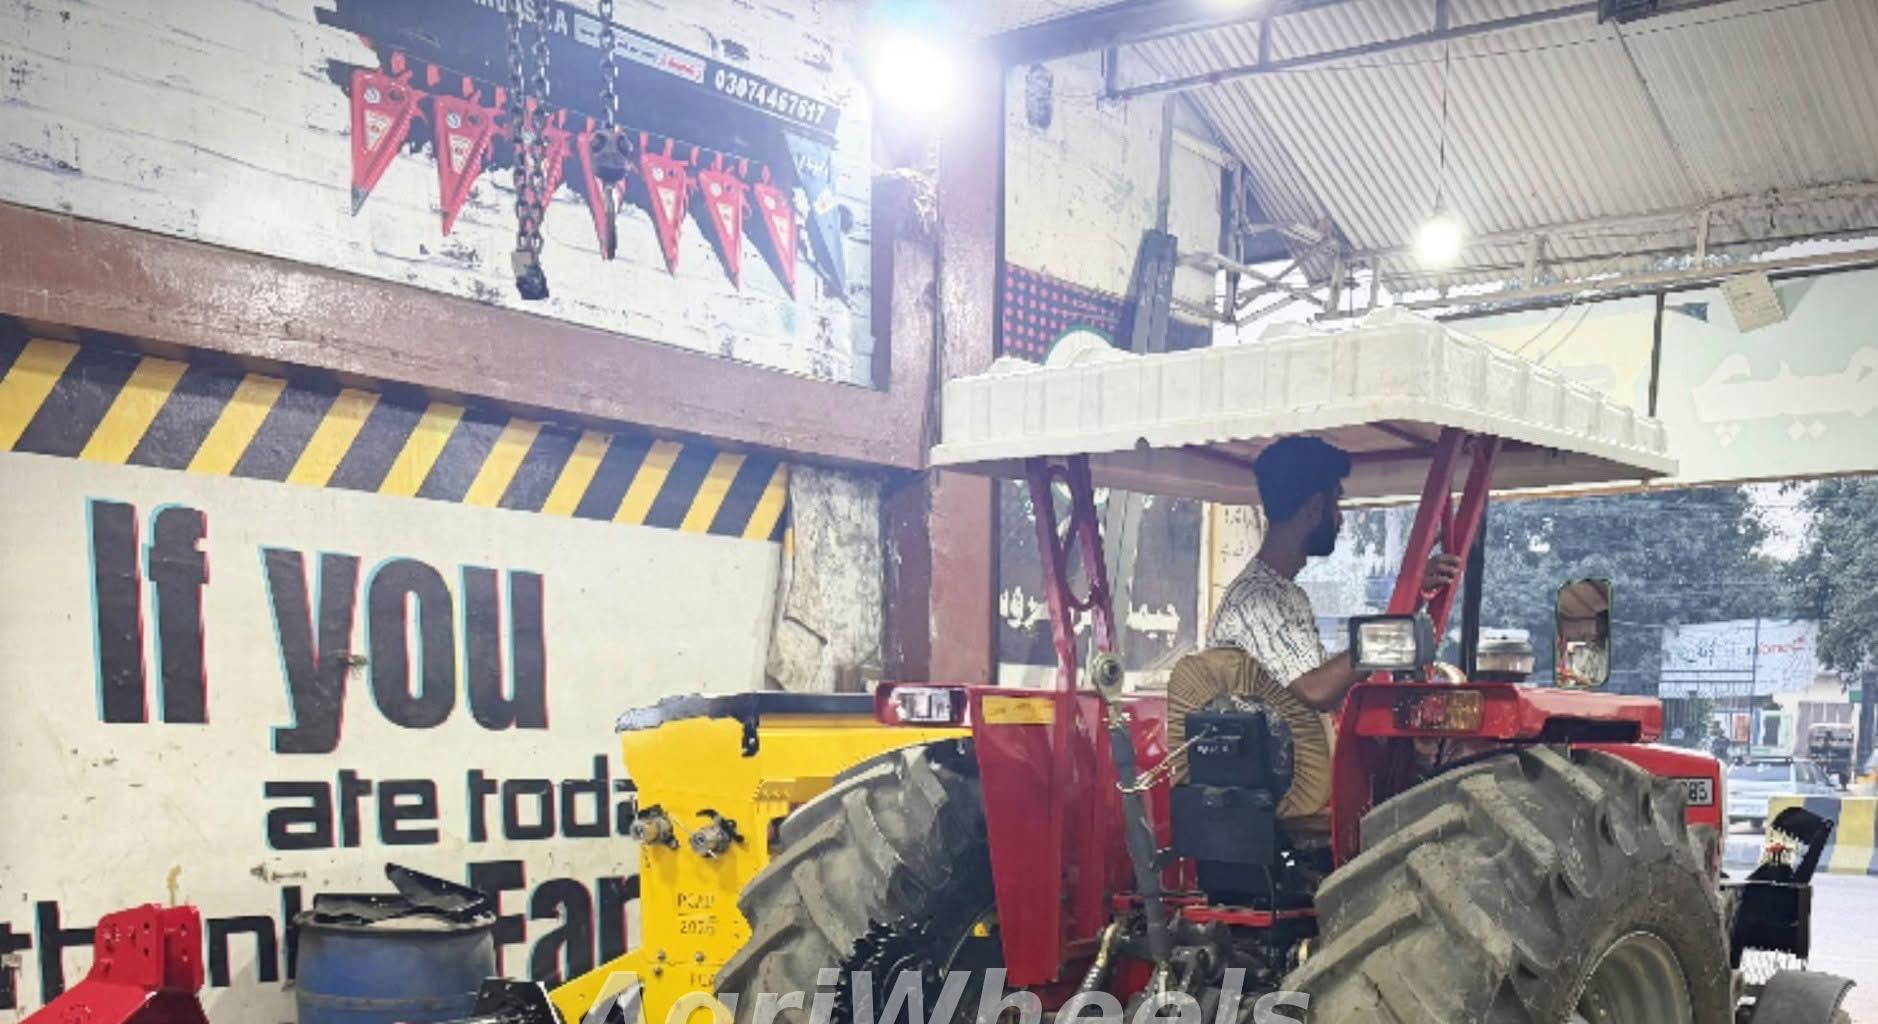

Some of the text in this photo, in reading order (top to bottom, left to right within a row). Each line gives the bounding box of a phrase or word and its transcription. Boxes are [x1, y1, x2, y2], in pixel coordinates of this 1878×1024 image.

[85, 495, 549, 754] If you
[262, 768, 440, 851] are
[1681, 780, 1708, 801] 85
